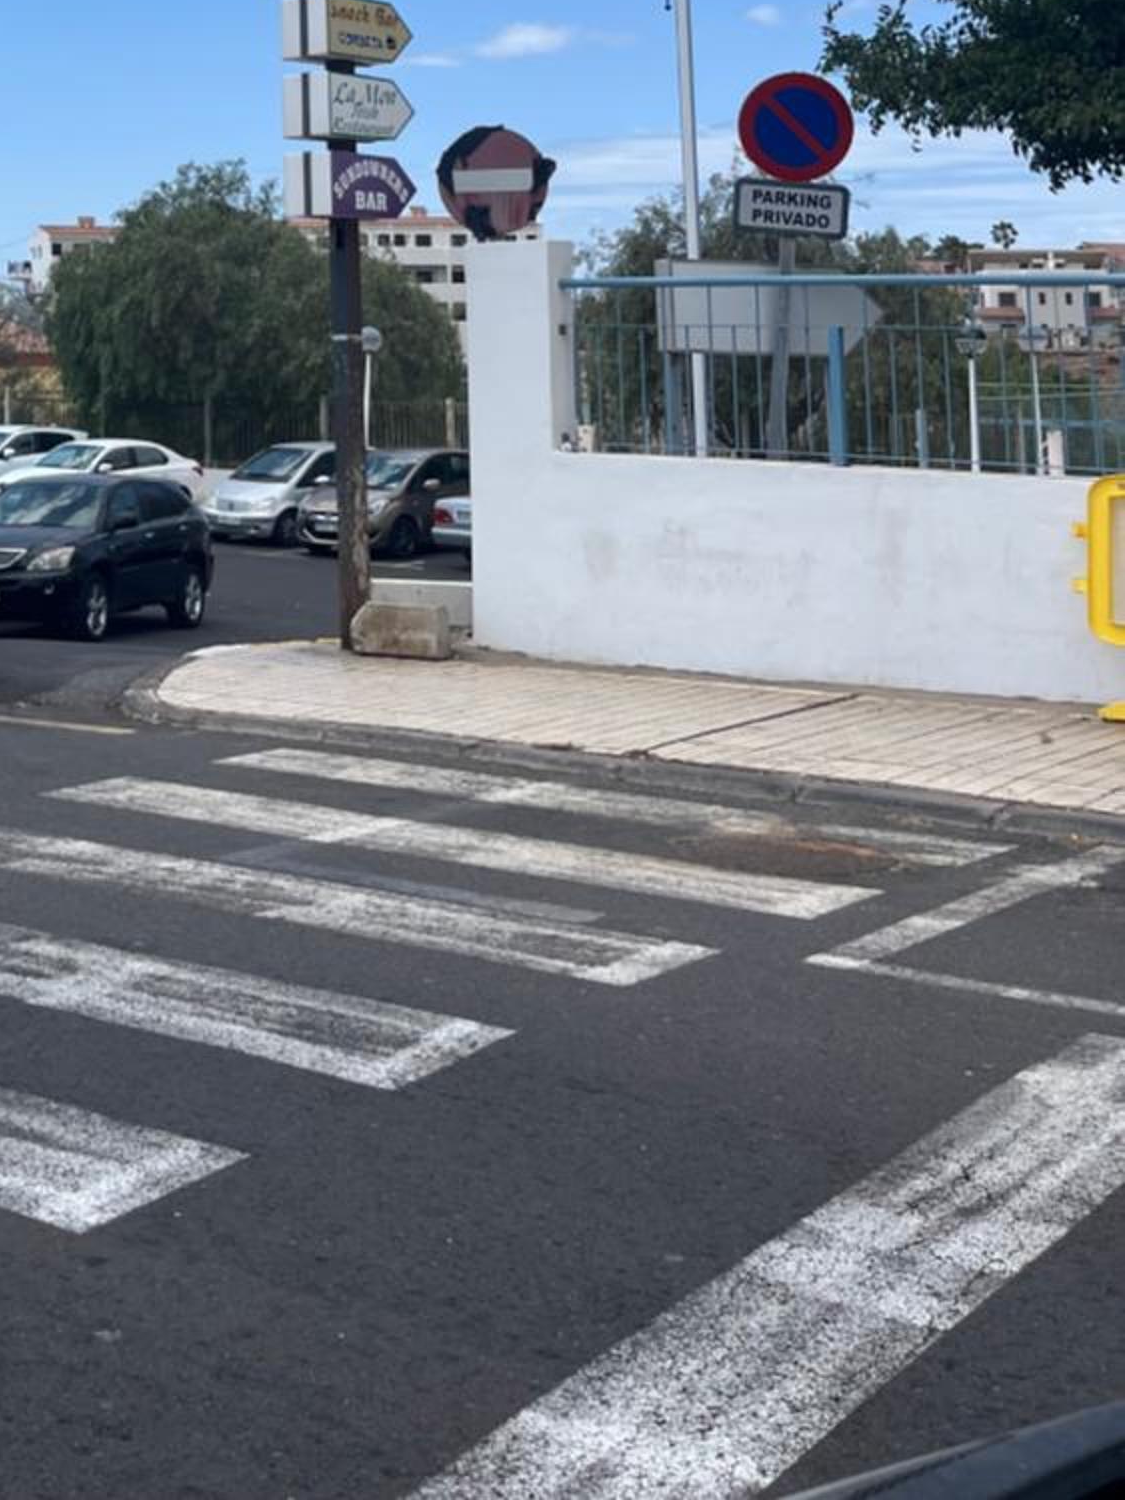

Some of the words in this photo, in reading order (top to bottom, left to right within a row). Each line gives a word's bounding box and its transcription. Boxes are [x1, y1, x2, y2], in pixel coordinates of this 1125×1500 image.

[355, 190, 388, 213] BAR
[751, 189, 832, 210] PARKING
[751, 208, 830, 229] PRIVADO
